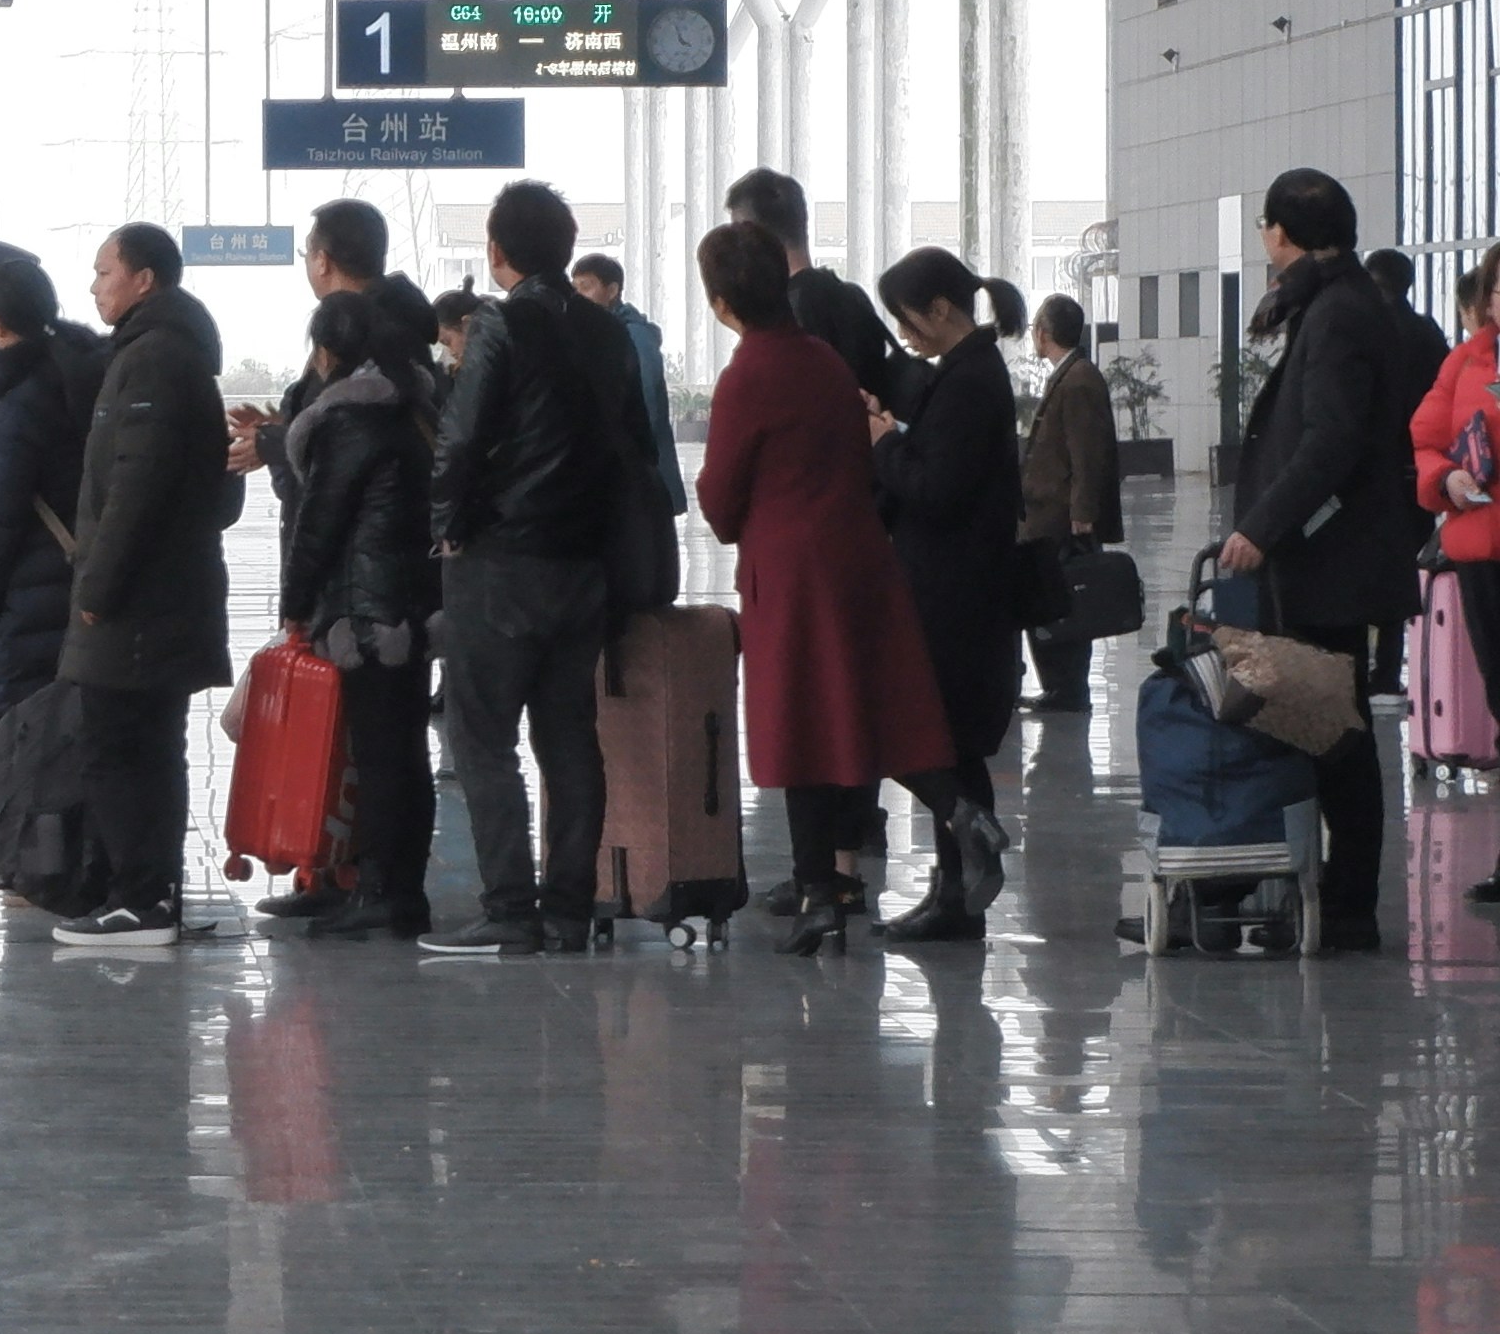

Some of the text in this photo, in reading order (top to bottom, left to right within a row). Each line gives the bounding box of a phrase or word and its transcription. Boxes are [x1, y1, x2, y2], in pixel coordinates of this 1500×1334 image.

[450, 5, 612, 24] G64 16:00 开
[364, 11, 391, 74] 1
[441, 31, 498, 52] 温州南
[564, 31, 622, 52] 济南西
[342, 112, 449, 144] 台州站
[307, 147, 484, 163] Taizhou Railway Station
[210, 233, 268, 250] 台州站
